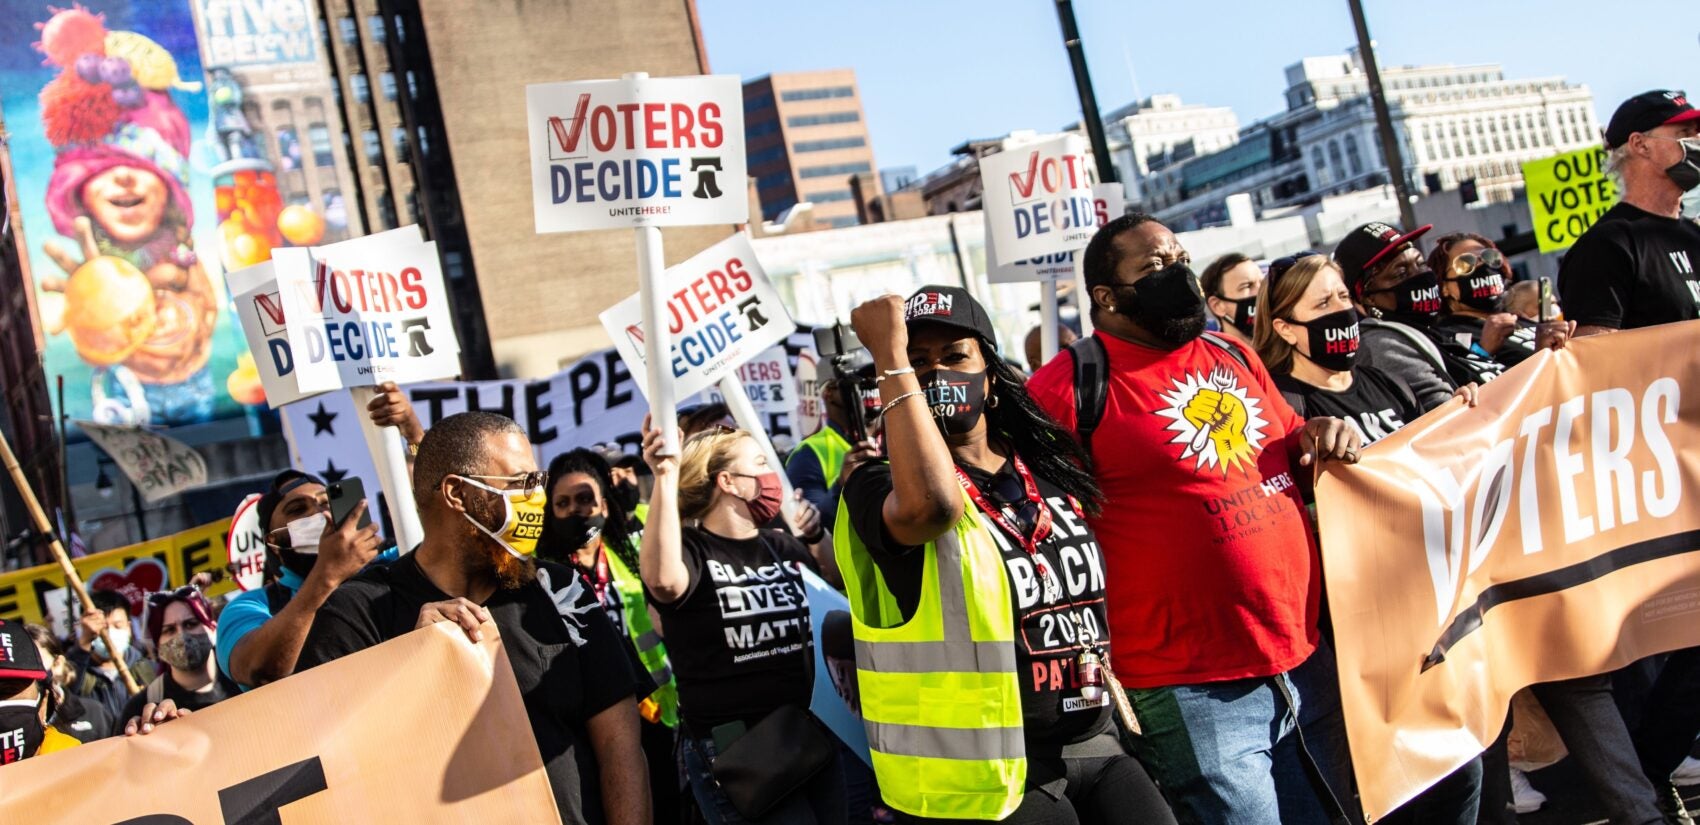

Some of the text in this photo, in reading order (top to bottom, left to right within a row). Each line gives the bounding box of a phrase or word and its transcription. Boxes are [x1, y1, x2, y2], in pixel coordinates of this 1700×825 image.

[548, 92, 724, 153] VOTERS
[551, 158, 682, 205] DECIDE
[1014, 196, 1093, 240] DECID
[295, 258, 427, 314] VOTERS
[303, 320, 400, 364] DECIDE
[671, 311, 743, 379] ECIDE
[739, 360, 782, 382] TERS
[410, 349, 632, 445] THE PE
[1417, 376, 1682, 628] VOTERS
[236, 531, 266, 553] UN
[514, 525, 543, 539] DEC
[238, 553, 264, 577] HE
[706, 559, 800, 584] BLACK
[1006, 541, 1106, 609] BACK
[718, 583, 805, 614] LIVES
